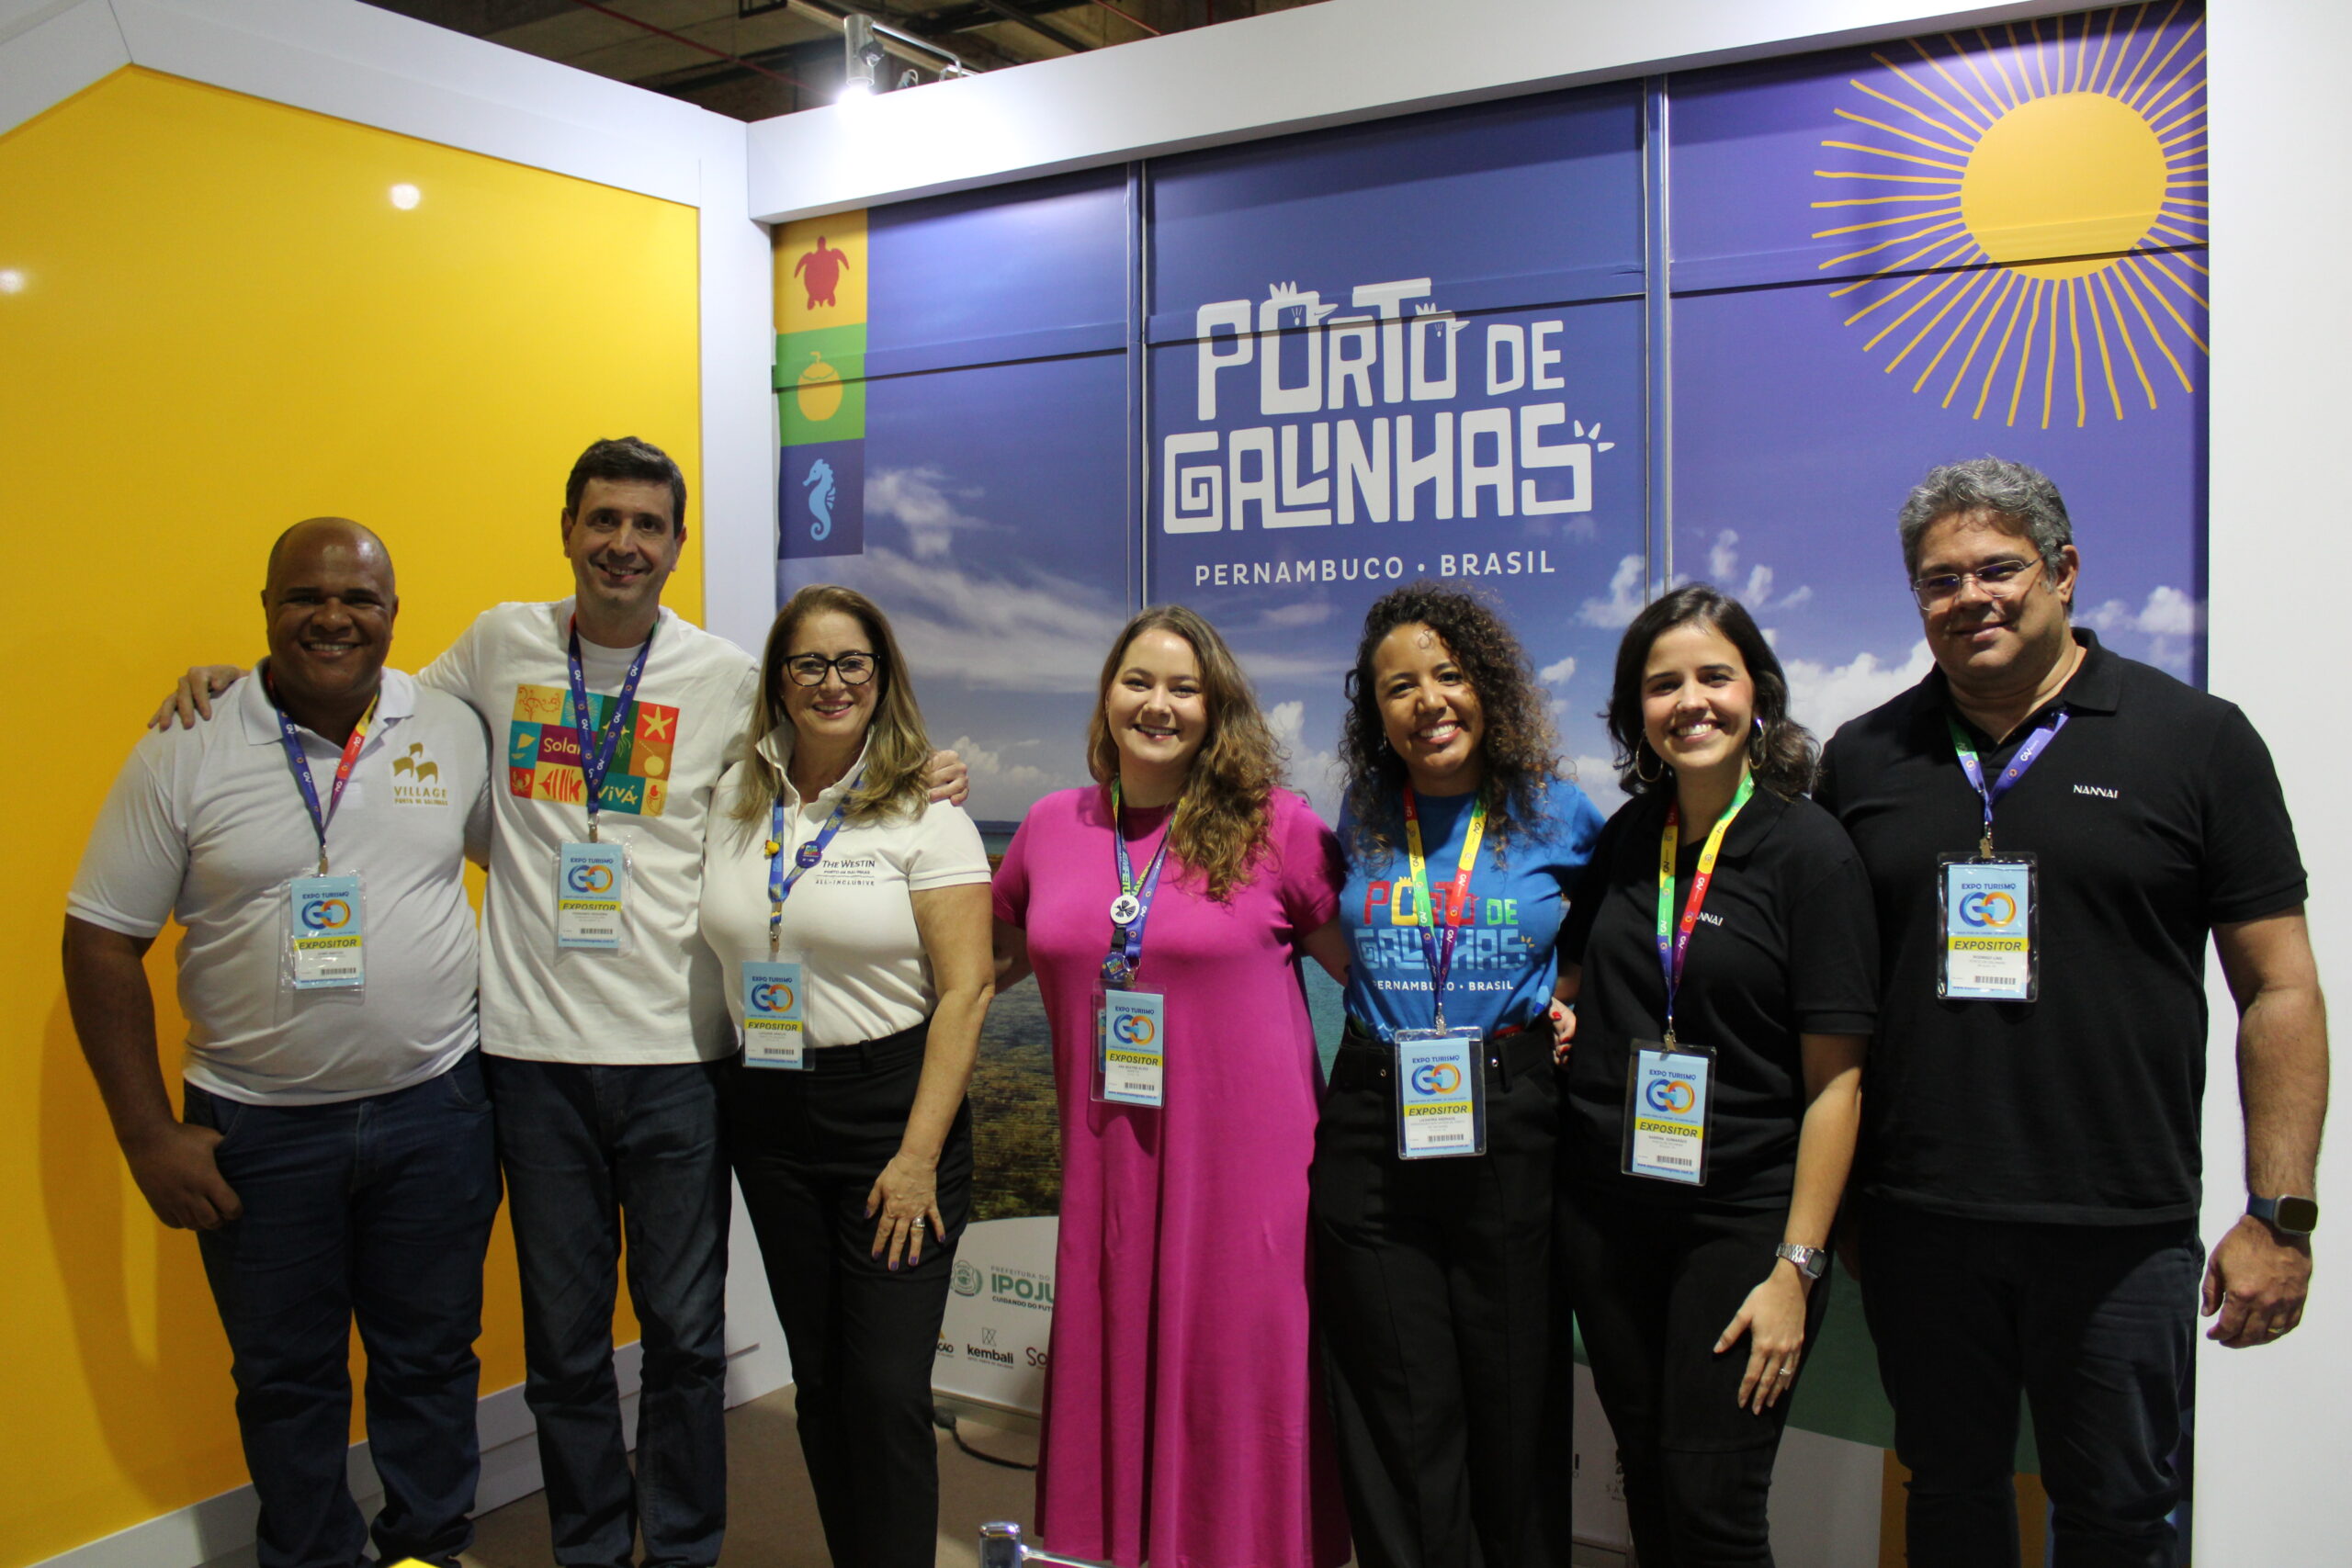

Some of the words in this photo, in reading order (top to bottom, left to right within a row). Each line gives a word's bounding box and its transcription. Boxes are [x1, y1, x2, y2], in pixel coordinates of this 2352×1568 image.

[1197, 277, 1464, 421] PORTO
[1487, 321, 1565, 395] DE
[1164, 402, 1592, 534] GALINHAS
[1196, 556, 1403, 586] PERNAMBUCO
[1441, 550, 1555, 578] BRASIL
[394, 786, 447, 798] VILLAGE
[2073, 784, 2119, 799] NANNAI
[563, 903, 616, 911] EXPOSITOR
[1487, 898, 1519, 926] DE
[300, 939, 357, 950] EXPOSITOR
[1354, 929, 1528, 970] GALIHAS
[1954, 941, 2022, 951] EXPOSITOR
[1374, 980, 1454, 991] ERNAMBUO
[1469, 980, 1514, 991] BRASIL
[748, 1021, 797, 1032] EXPOSITOR
[1110, 1054, 1159, 1066] EXPOSITOR
[1431, 1055, 1460, 1063] TURISMO
[1668, 1071, 1696, 1080] TURISMO
[1408, 1105, 1468, 1116] EXPOSITOR
[1640, 1122, 1698, 1137] EXPOSITOR
[990, 1266, 1036, 1279] PREFEITURA
[992, 1295, 1026, 1307] CUIDANDO
[967, 1343, 1013, 1364] kembali
